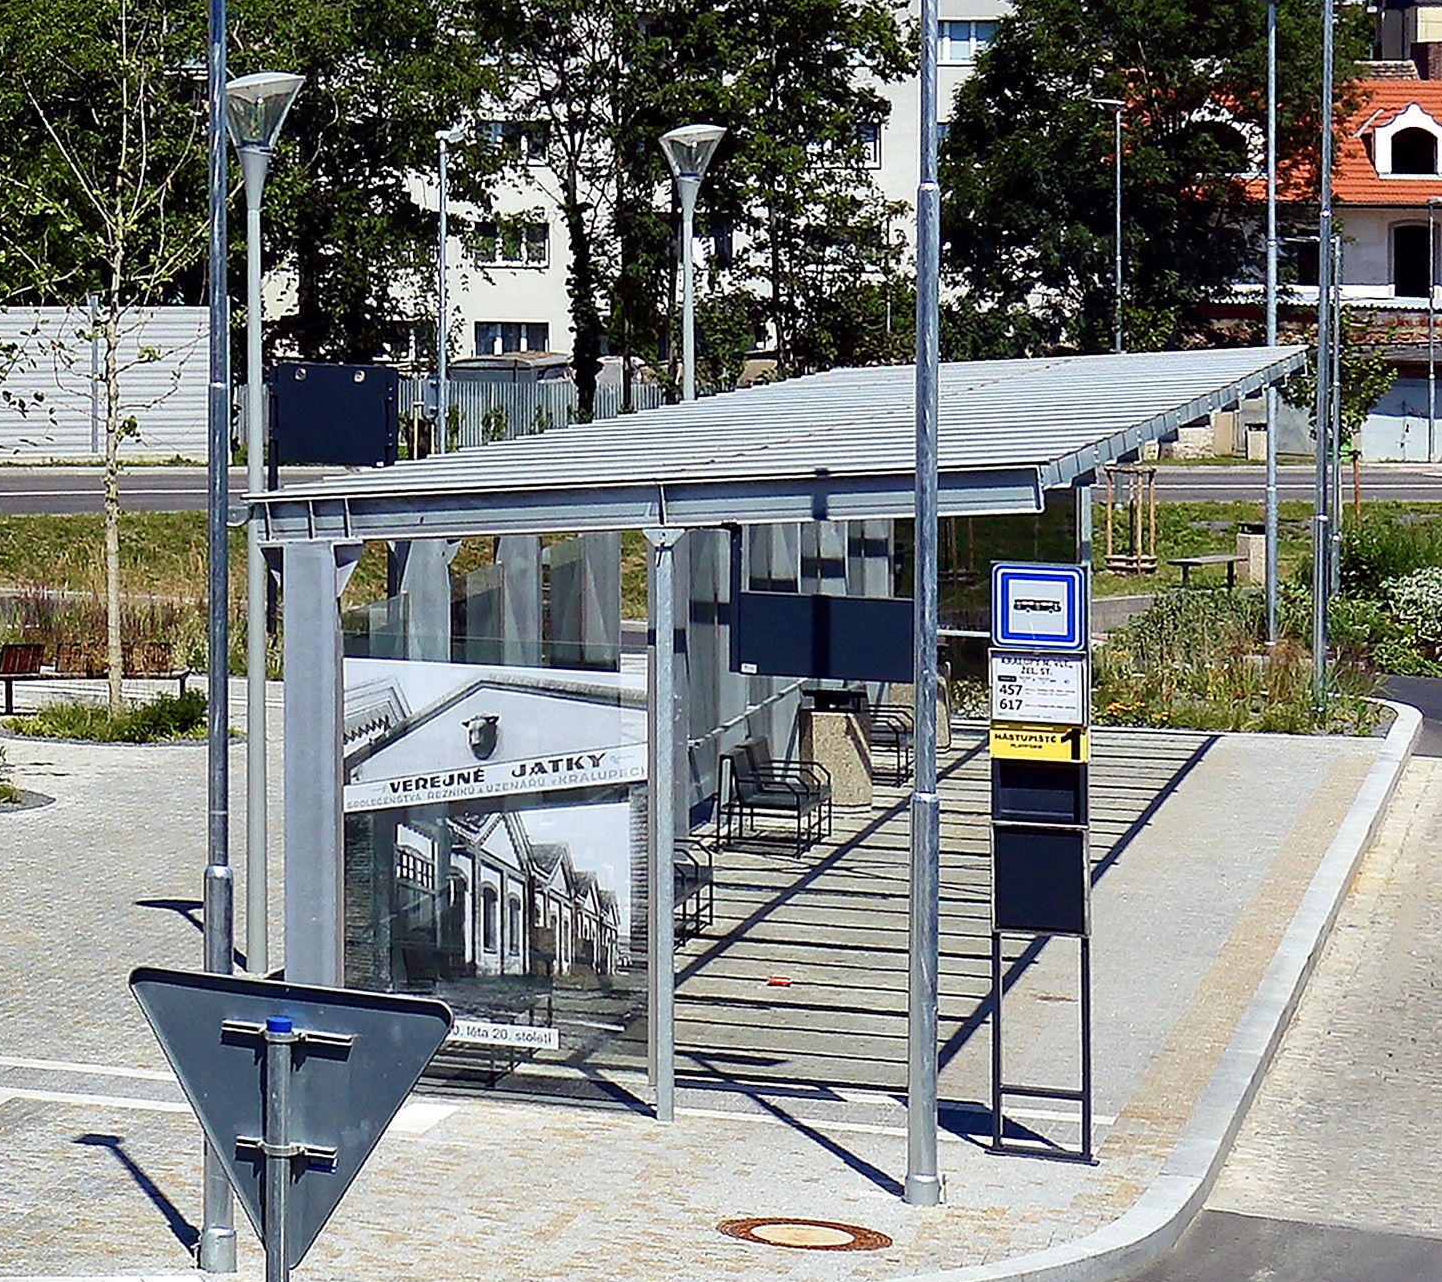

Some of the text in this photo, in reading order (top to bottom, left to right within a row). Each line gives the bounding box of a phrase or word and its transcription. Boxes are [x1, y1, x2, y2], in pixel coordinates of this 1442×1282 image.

[999, 684, 1023, 696] 457
[999, 698, 1023, 710] 617
[1061, 728, 1082, 760] 1
[511, 753, 607, 778] JATKY
[492, 1028, 512, 1040] 20.
